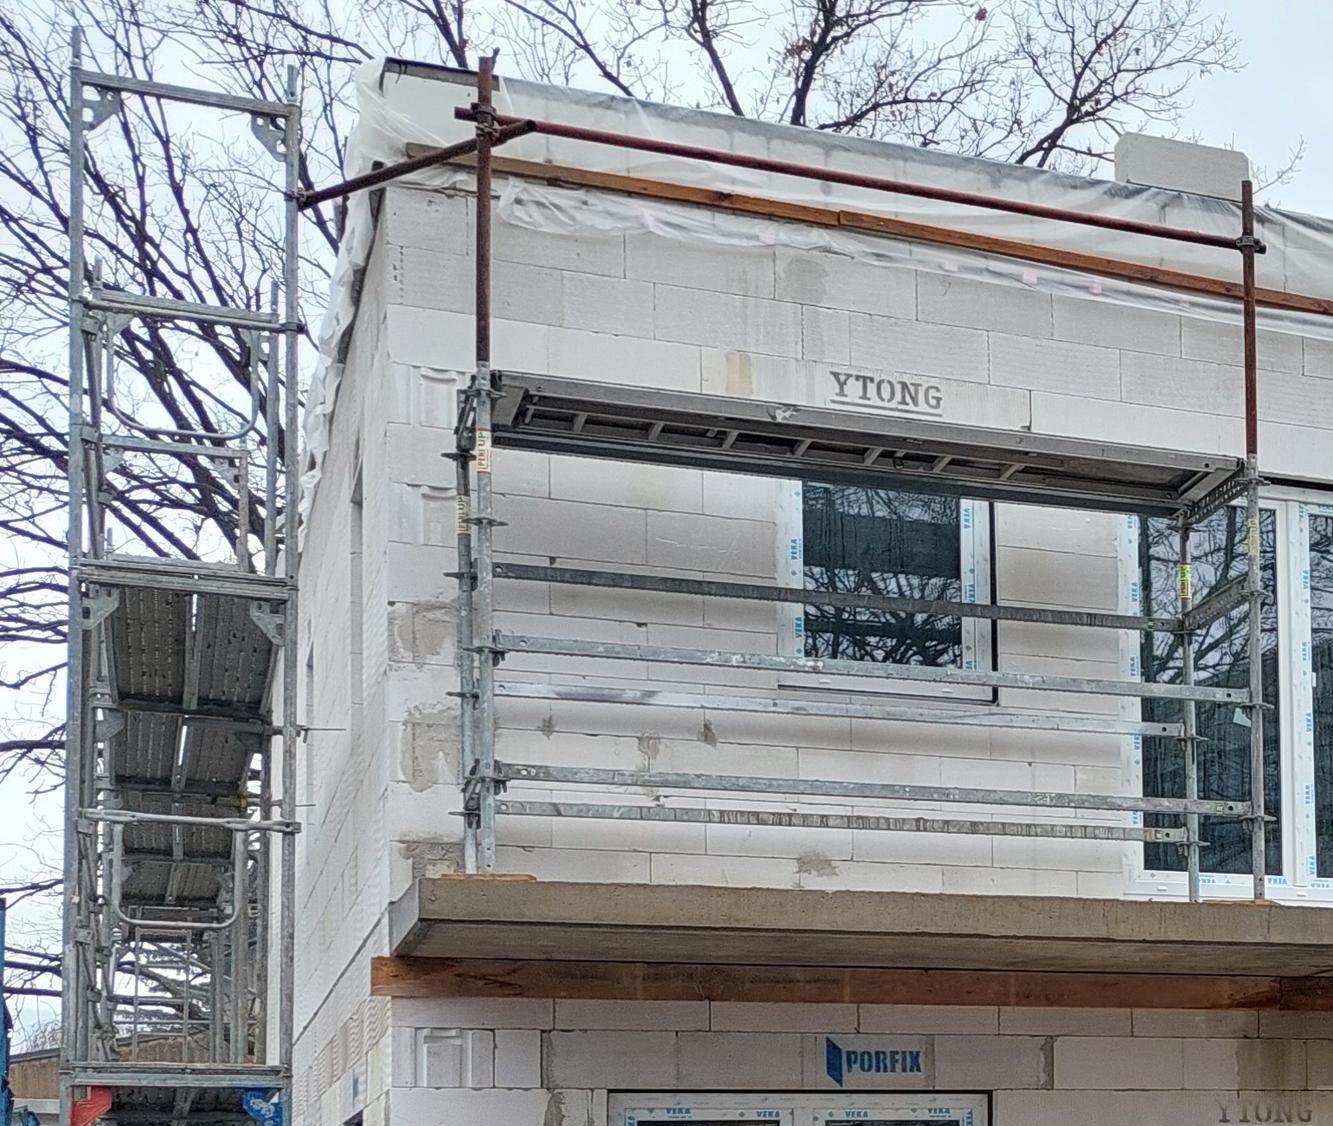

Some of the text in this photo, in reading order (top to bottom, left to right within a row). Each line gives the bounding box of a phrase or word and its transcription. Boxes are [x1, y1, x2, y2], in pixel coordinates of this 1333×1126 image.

[829, 371, 944, 411] YTONG
[963, 508, 971, 529] VEKA
[845, 1048, 922, 1074] PORFIX
[1215, 1101, 1313, 1123] YTONG
